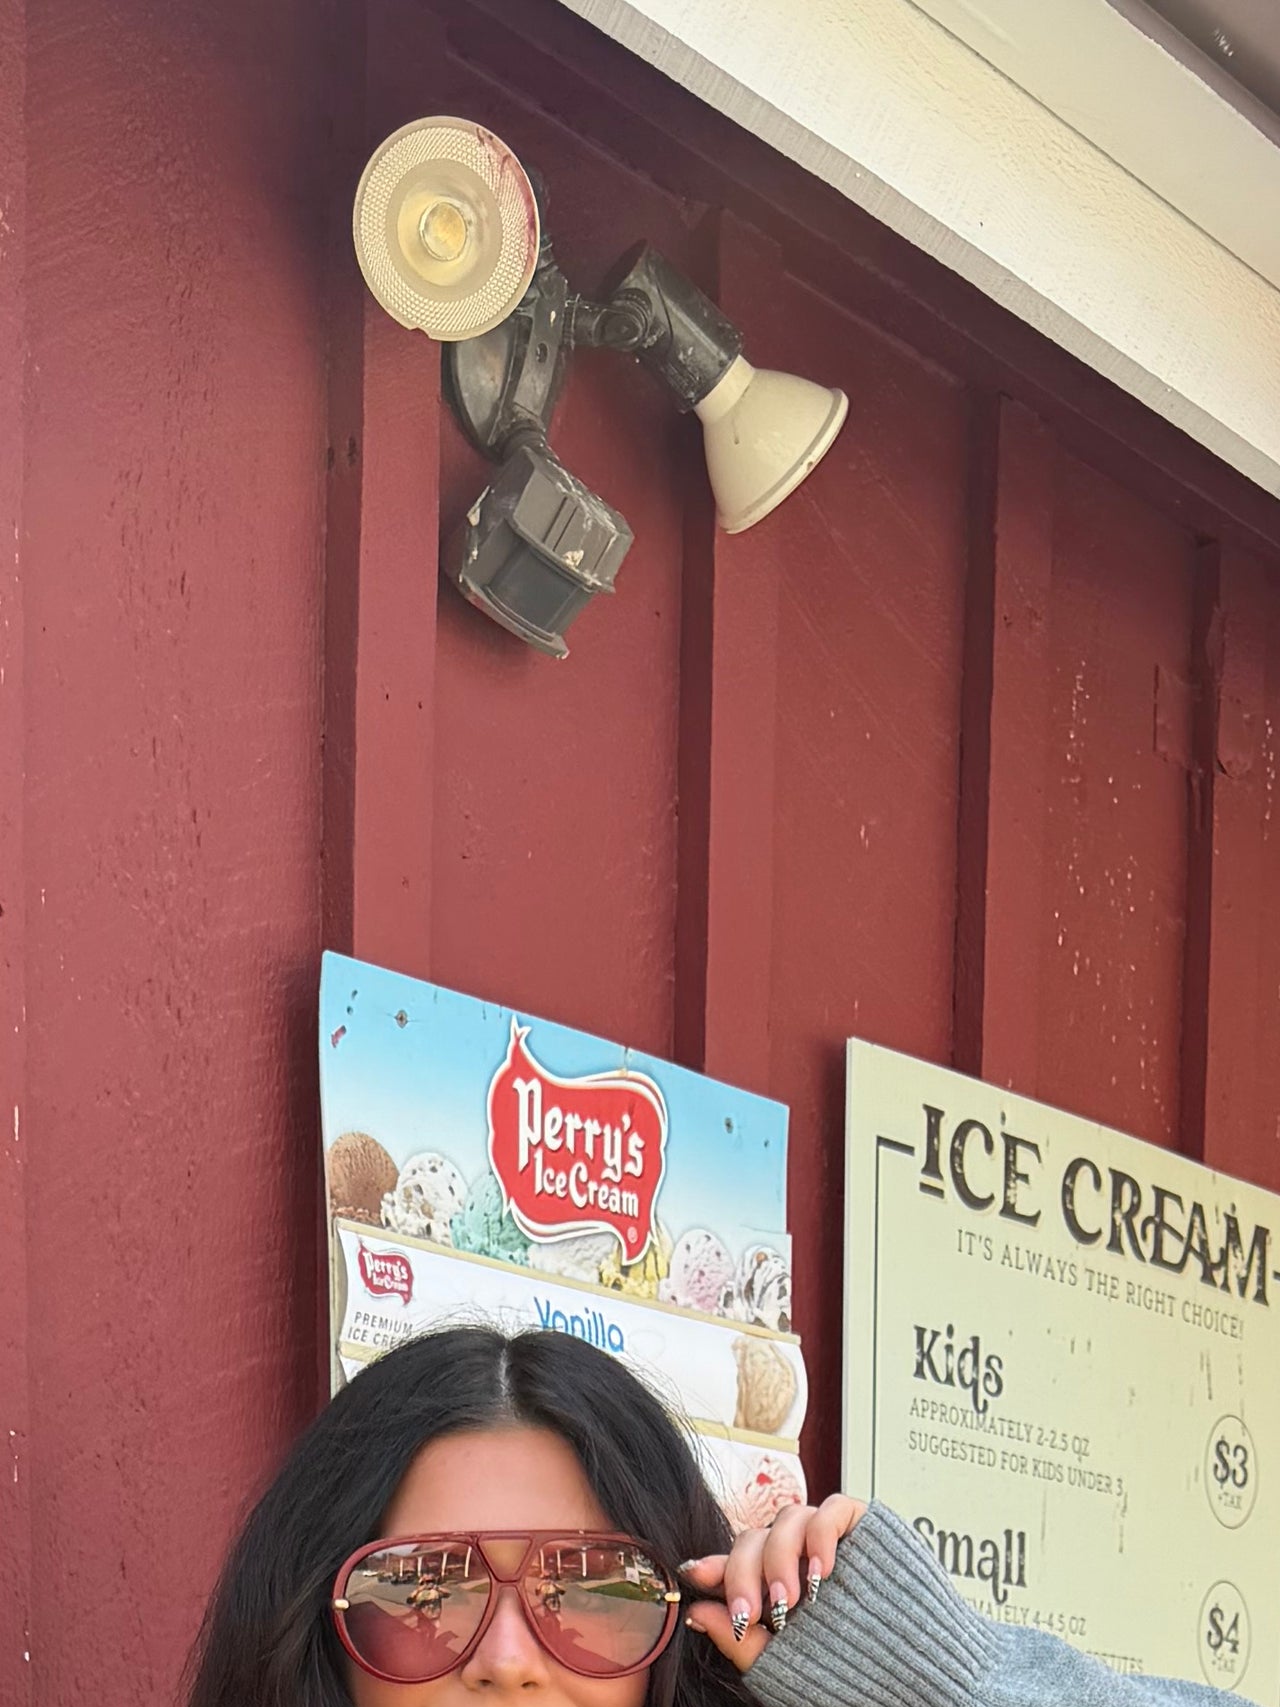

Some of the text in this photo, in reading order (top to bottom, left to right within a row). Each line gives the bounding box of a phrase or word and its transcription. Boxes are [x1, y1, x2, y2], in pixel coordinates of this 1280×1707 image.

[513, 1077, 645, 1182] Perry's
[534, 1148, 639, 1218] Ice Cream
[920, 1103, 1270, 1306] ICE CREAM
[957, 1229, 1245, 1341] IT'S ALWAYS THE RIGHT CHOICE!
[347, 1326, 368, 1342] ICE
[354, 1311, 413, 1336] PREMIUM
[913, 1323, 1004, 1414] Kids
[909, 1397, 1034, 1444] APPROXIMATELY
[908, 1430, 997, 1468] SUGGESTED
[1000, 1450, 1029, 1475] FOR
[1032, 1458, 1064, 1484] KIDS
[1067, 1466, 1114, 1495] UNDER
[1213, 1435, 1248, 1489] $3
[913, 1517, 1027, 1605] Small
[1207, 1602, 1240, 1656] $4
